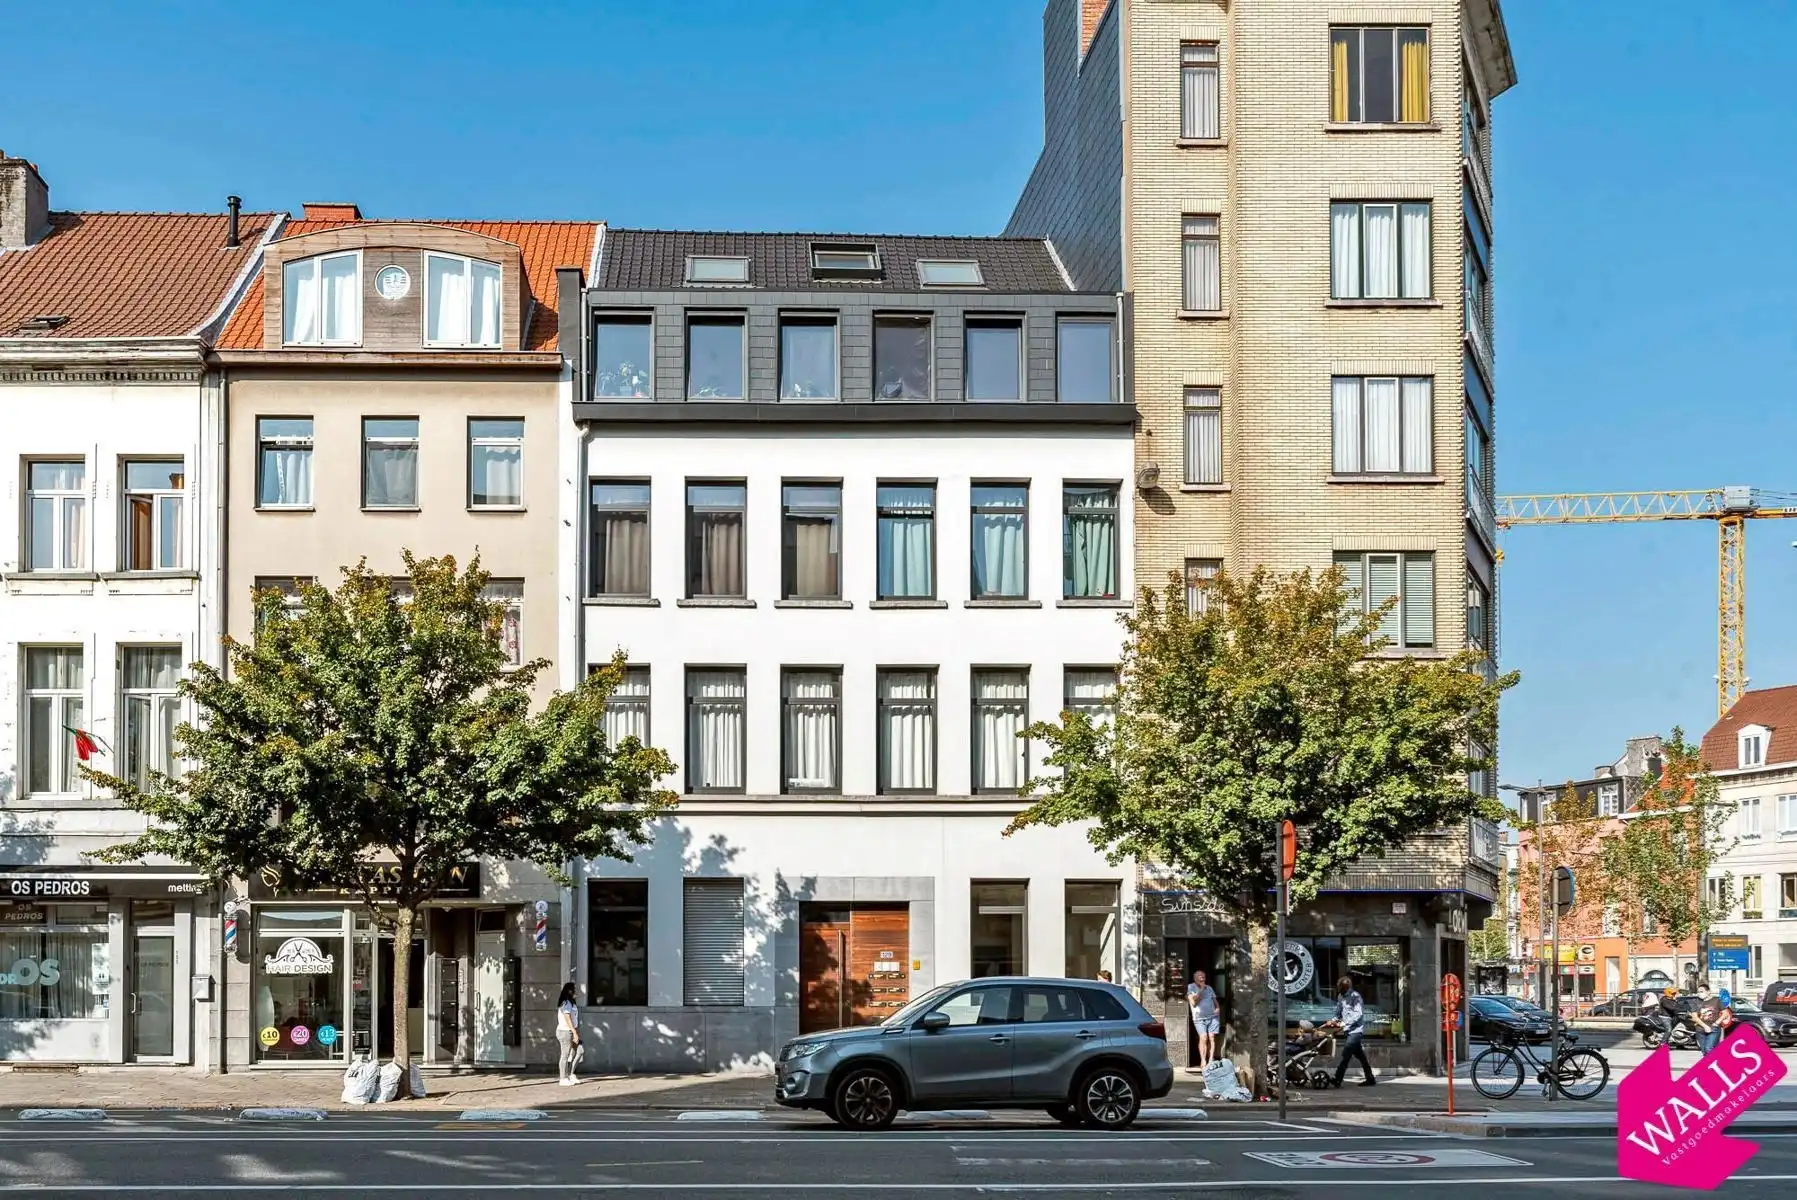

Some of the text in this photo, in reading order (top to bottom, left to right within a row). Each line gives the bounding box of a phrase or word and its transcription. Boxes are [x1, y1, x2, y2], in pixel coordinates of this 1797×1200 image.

[11, 880, 90, 895] OS PEDROS
[267, 964, 332, 973] HAIR DESIGN
